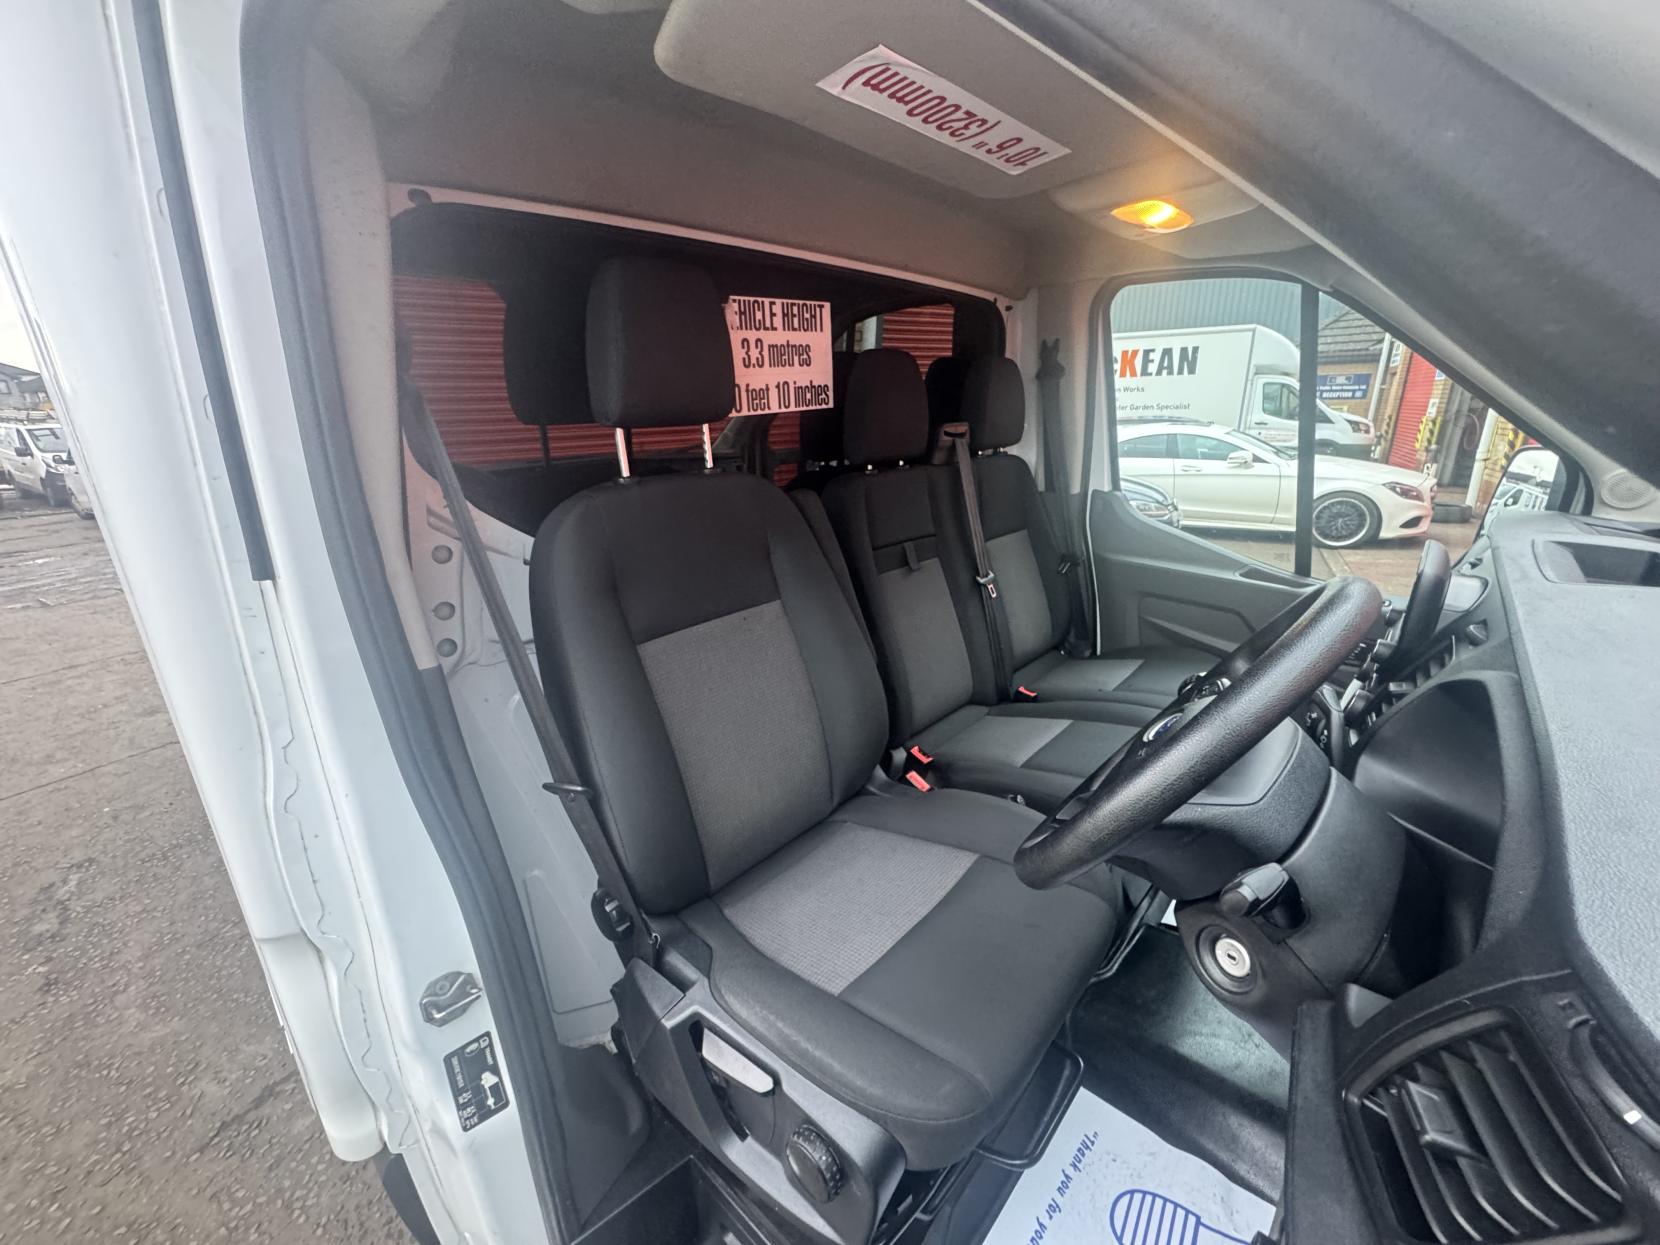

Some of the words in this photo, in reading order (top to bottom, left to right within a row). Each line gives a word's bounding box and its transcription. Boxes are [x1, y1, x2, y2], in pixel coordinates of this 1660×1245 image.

[730, 298, 778, 332] HICLE
[781, 301, 825, 333] HEIGHT
[740, 337, 765, 369] 3.3
[767, 339, 812, 368] metres
[734, 383, 743, 414] 0
[744, 382, 771, 413] feet
[774, 380, 790, 410] 10
[793, 379, 830, 408] inches
[1123, 385, 1145, 393] Works
[1129, 403, 1155, 411] Garden
[1156, 402, 1191, 413] Specialist
[1055, 1167, 1074, 1198] you
[1045, 1197, 1062, 1221] for
